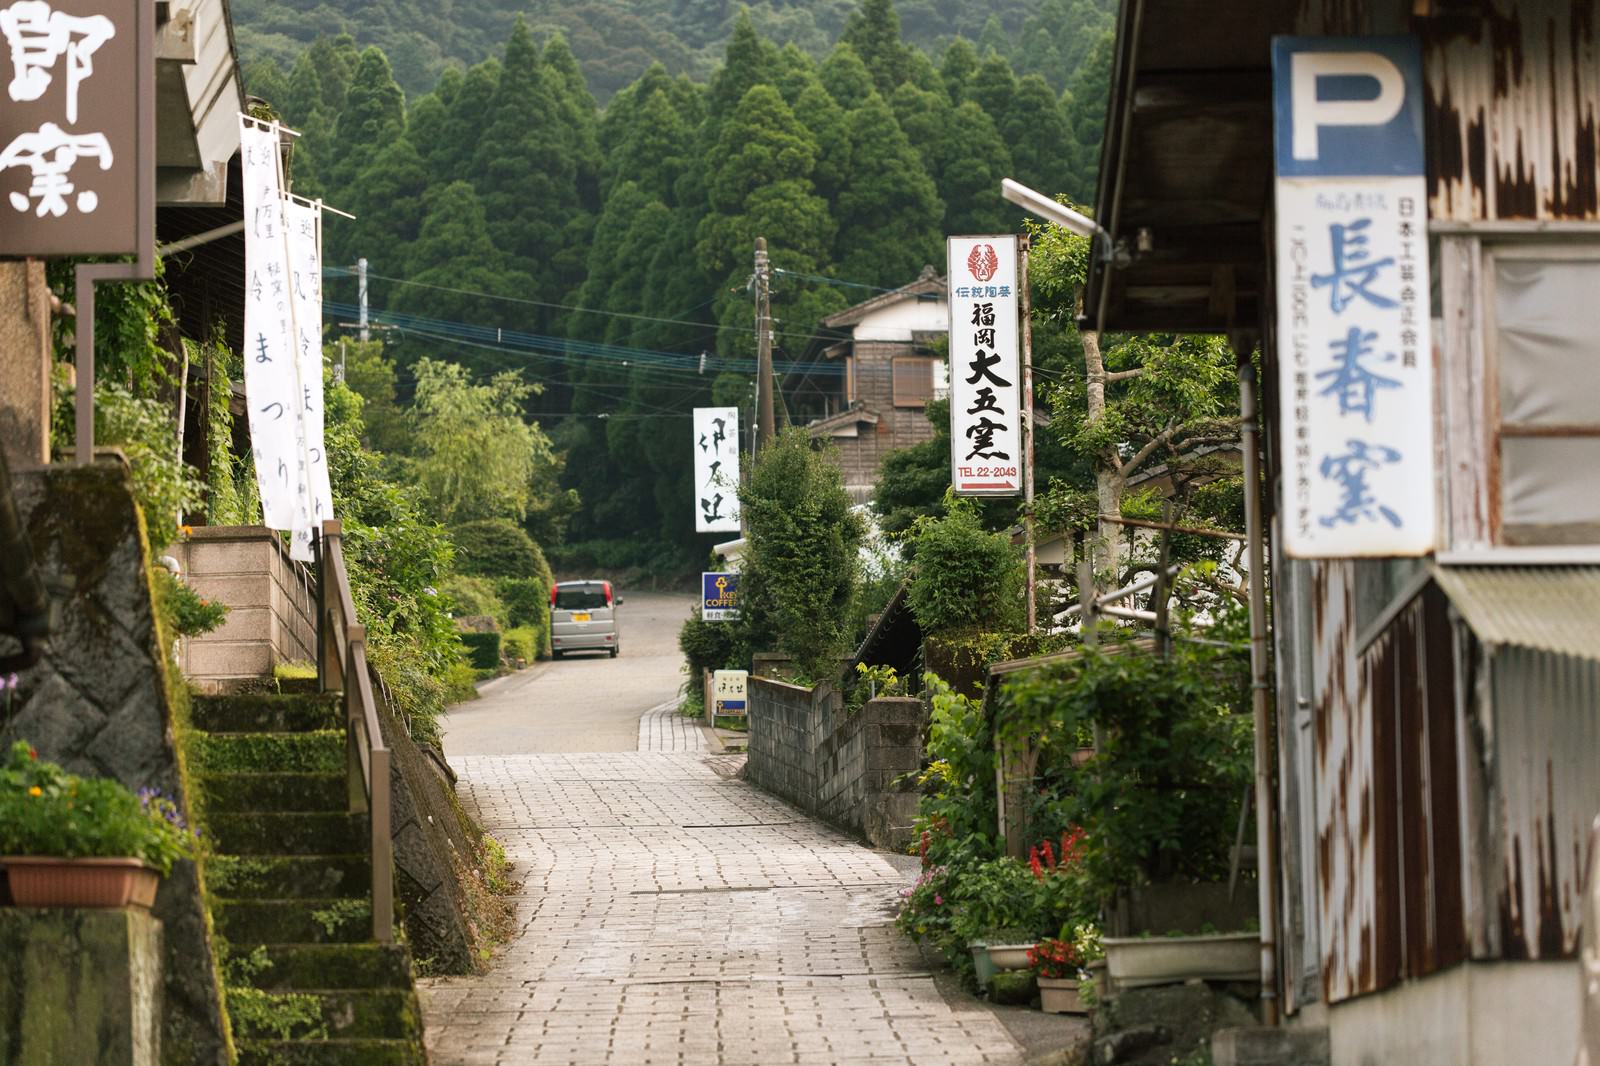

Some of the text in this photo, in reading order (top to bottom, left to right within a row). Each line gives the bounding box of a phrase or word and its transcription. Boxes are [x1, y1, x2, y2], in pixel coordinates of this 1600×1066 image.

[1292, 52, 1405, 161] P
[955, 285, 1012, 298] 伝統陶芸
[958, 466, 1017, 477] TEL 22-2043
